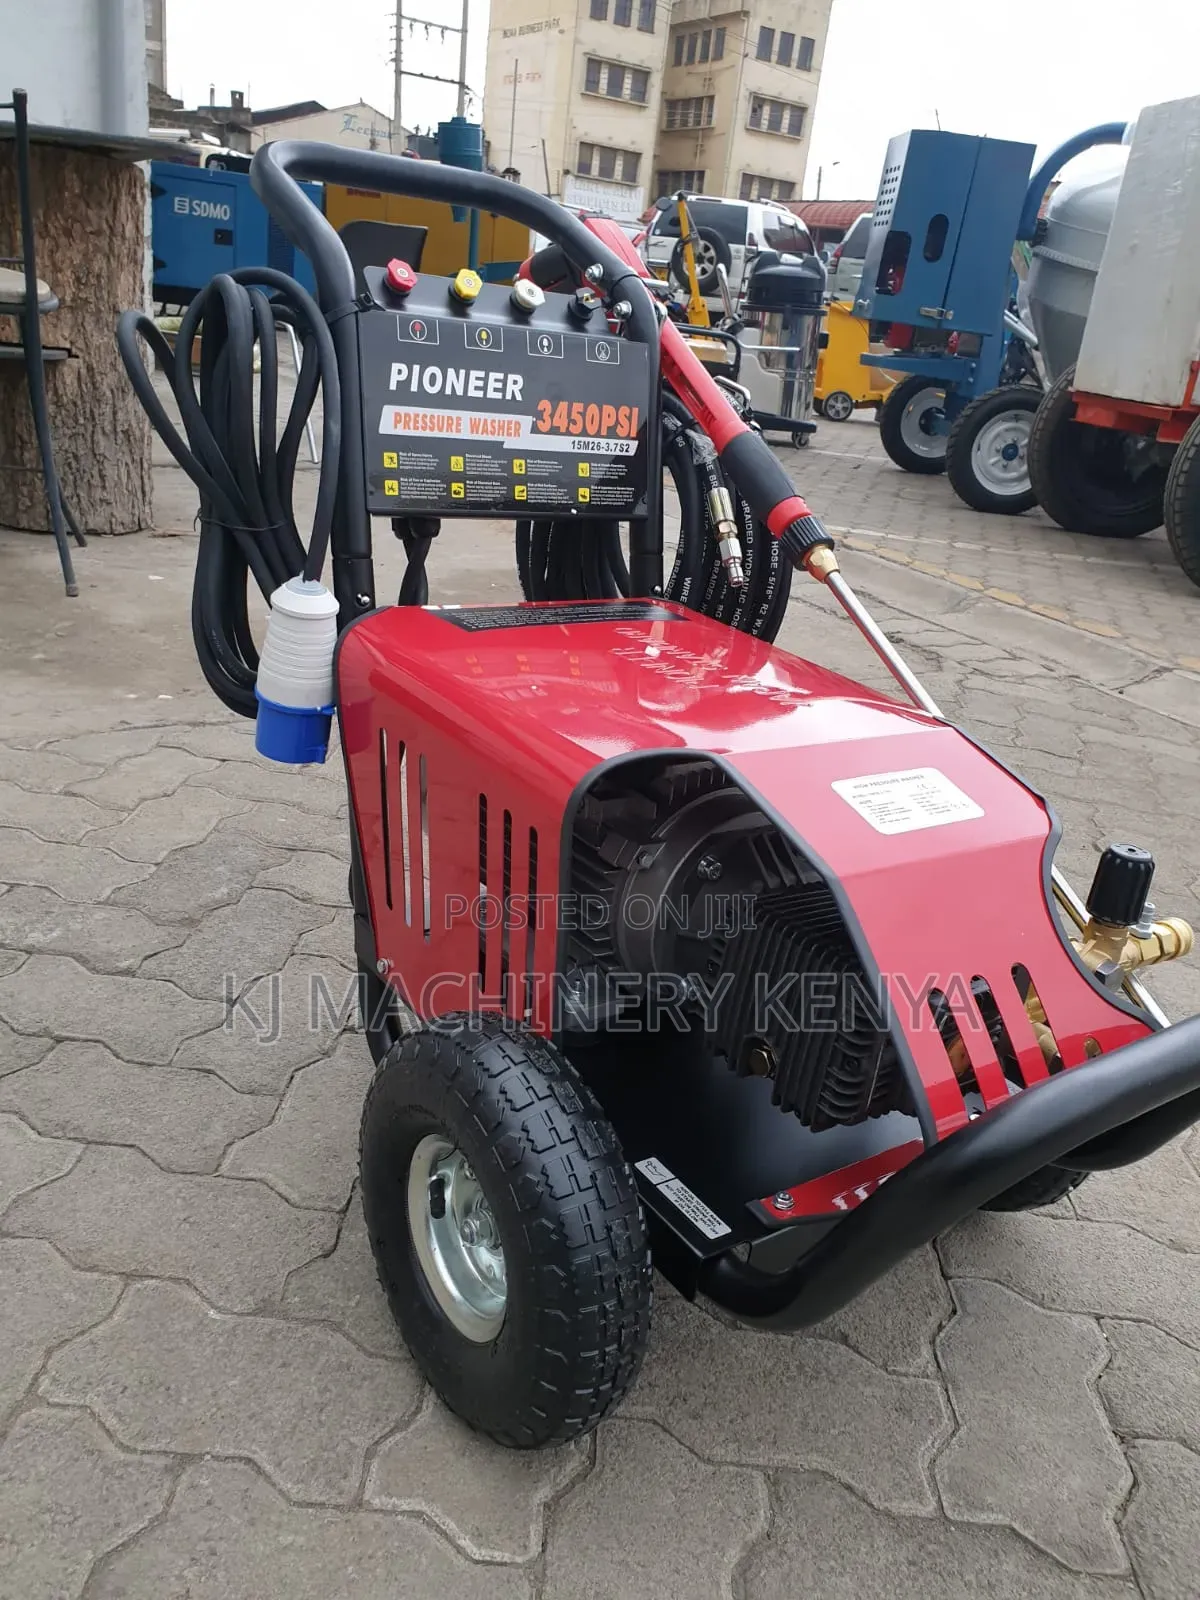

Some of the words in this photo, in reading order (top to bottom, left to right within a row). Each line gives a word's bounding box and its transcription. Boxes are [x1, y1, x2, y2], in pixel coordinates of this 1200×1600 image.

[192, 200, 230, 220] SDMO
[389, 362, 525, 401] PIONEER
[393, 411, 462, 434] PRESSURE
[469, 416, 522, 438] WASHER
[536, 400, 640, 438] 3450PSI
[570, 440, 630, 453] 15M26-3.7S2
[770, 540, 779, 569] HOSE
[679, 576, 692, 603] WIRE
[738, 549, 754, 604] HYDRAULIC
